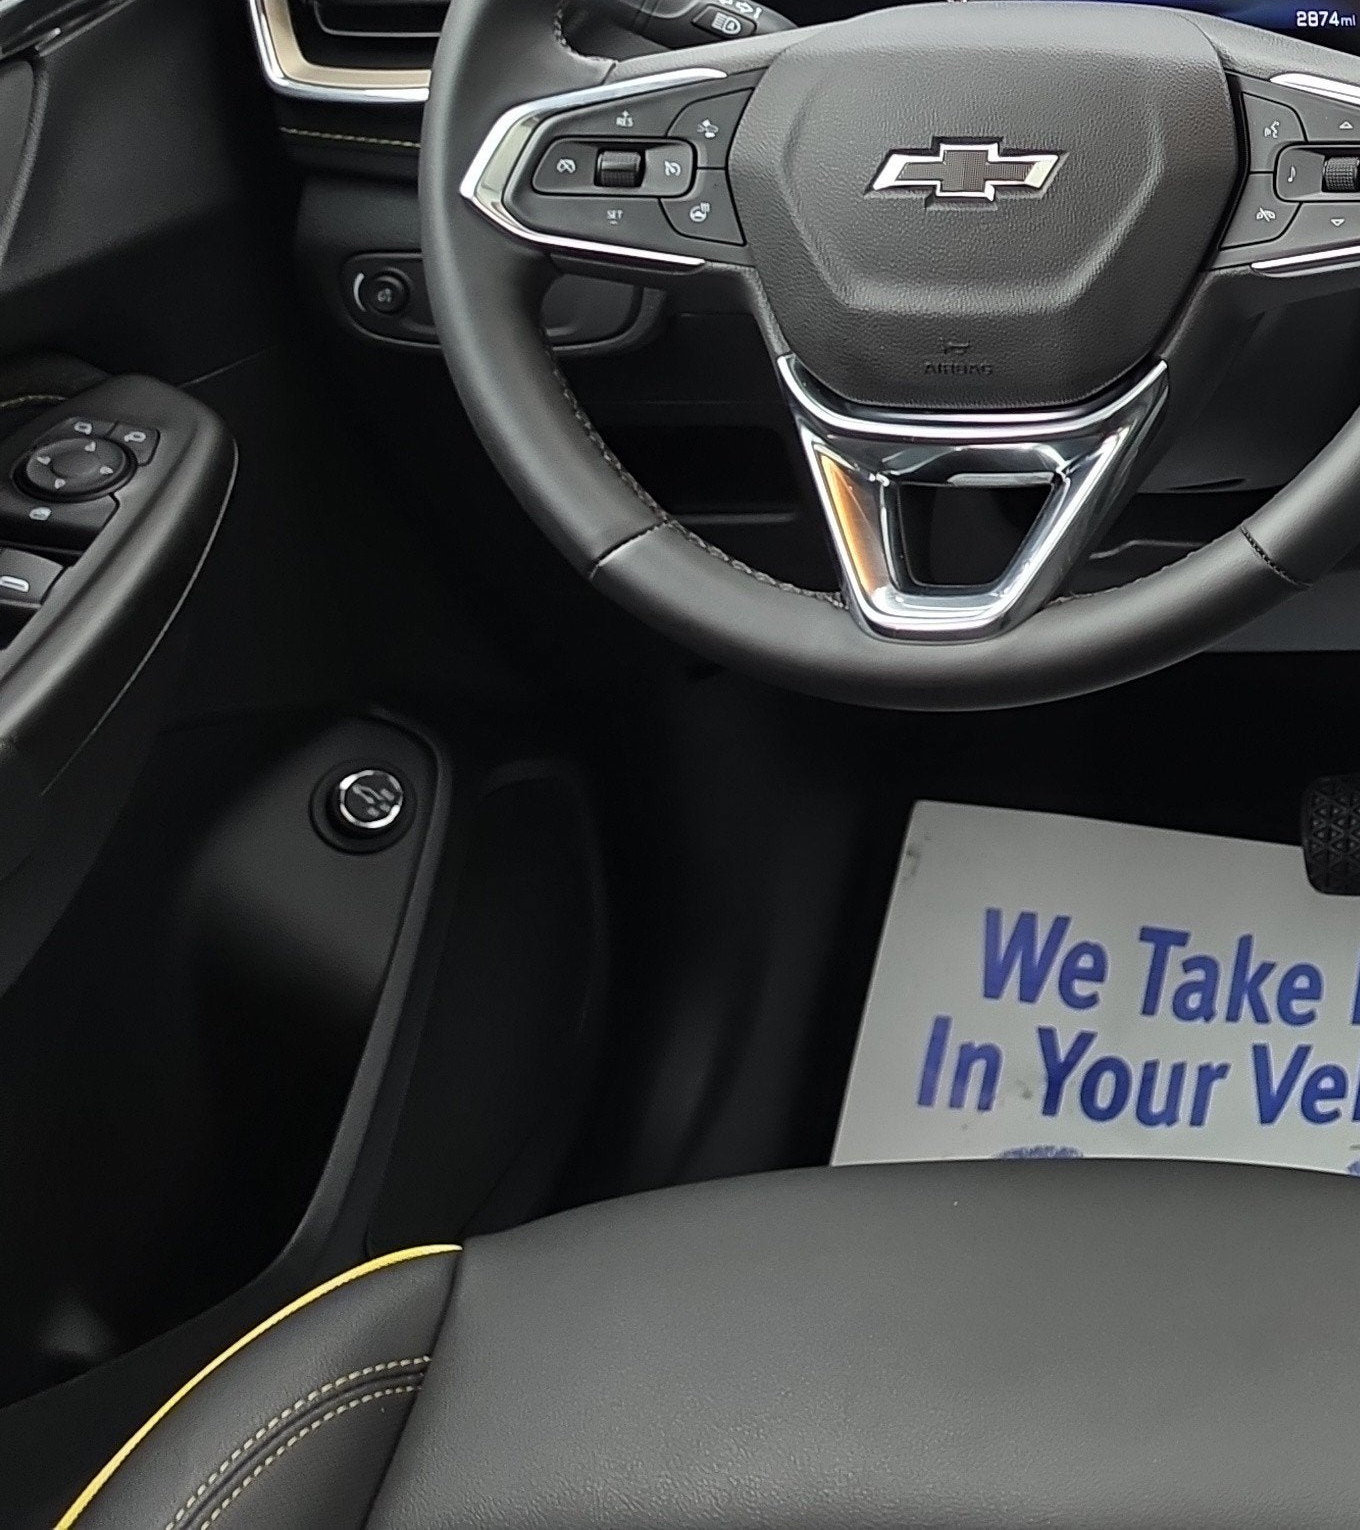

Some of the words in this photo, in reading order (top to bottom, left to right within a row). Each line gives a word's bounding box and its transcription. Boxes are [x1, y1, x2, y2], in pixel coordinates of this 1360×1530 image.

[616, 116, 634, 128] RES
[607, 209, 623, 220] SET
[982, 907, 1108, 1011] We
[1138, 925, 1324, 1026] Take
[916, 1015, 1001, 1112] In
[1035, 1026, 1231, 1127] Your
